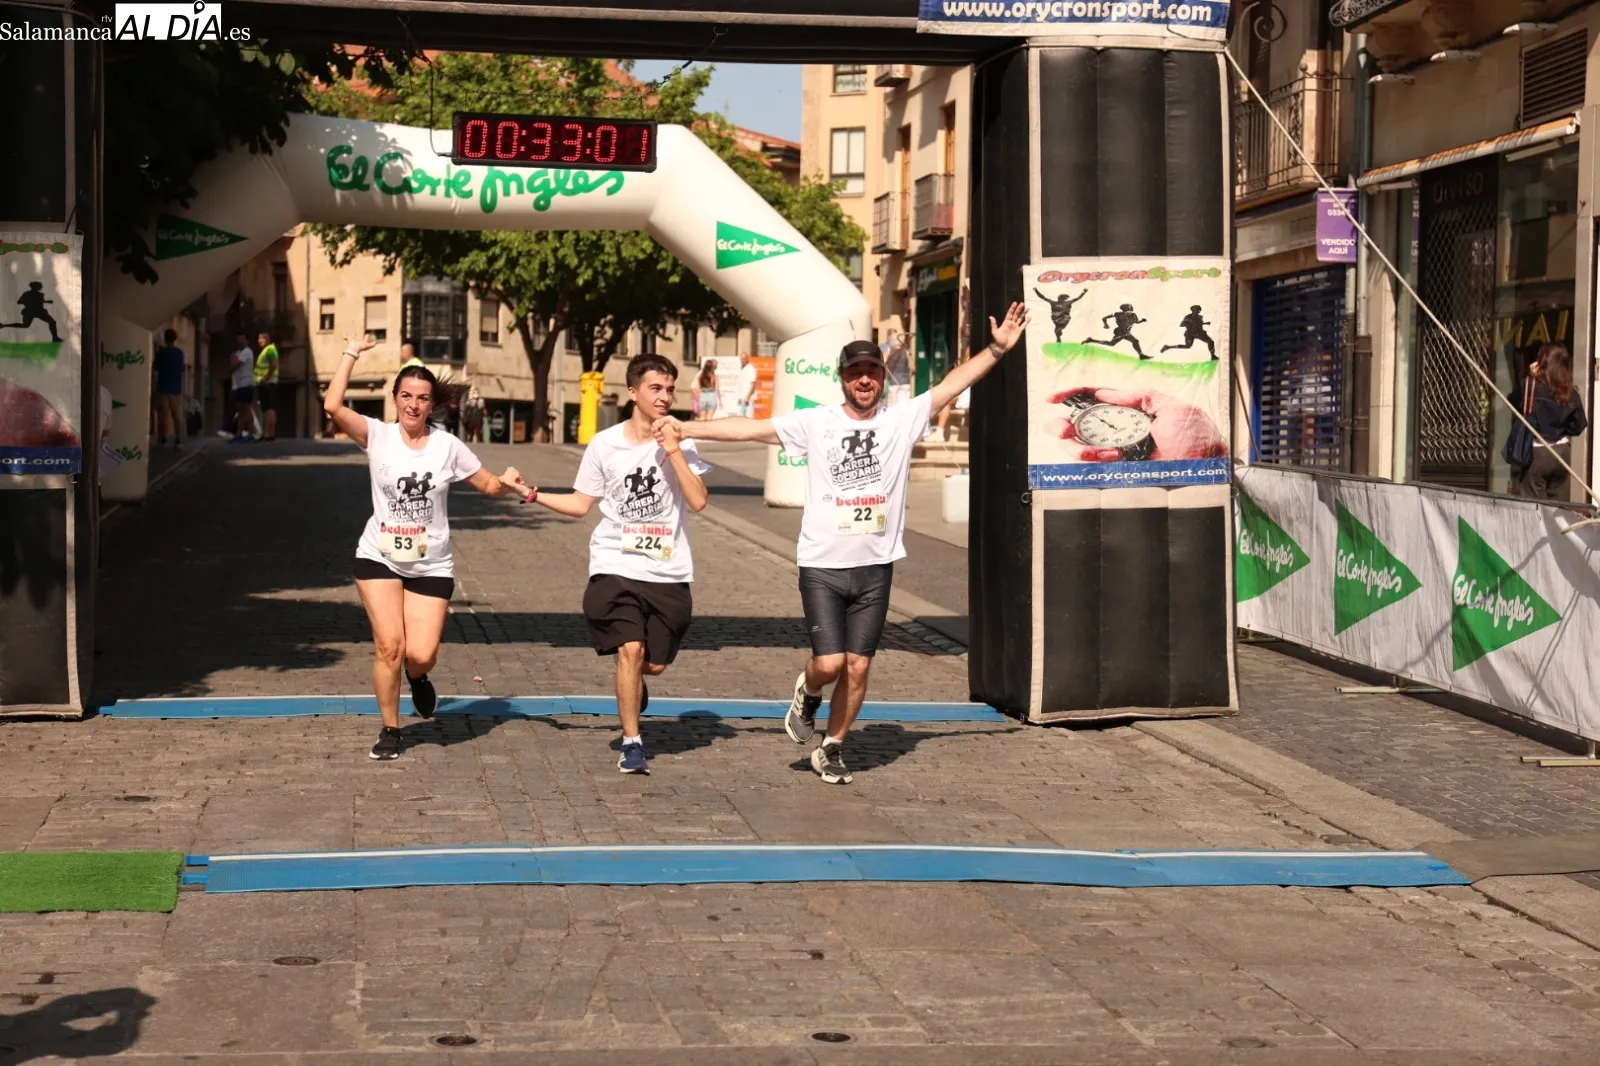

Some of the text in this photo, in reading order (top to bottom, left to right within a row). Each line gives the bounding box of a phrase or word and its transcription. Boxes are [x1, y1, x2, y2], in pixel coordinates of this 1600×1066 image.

[943, 0, 1212, 22] www.orycronsport.com
[465, 120, 648, 163] 00:33:01
[326, 145, 370, 192] El
[373, 151, 473, 198] Corte
[1321, 238, 1356, 246] VENDIDO
[785, 357, 795, 374] El
[796, 359, 831, 377] Corte
[831, 455, 879, 475] CARRERA
[1043, 467, 1226, 482] www.orycronsport.com
[854, 507, 872, 521] 22
[623, 523, 673, 536] bedunia
[394, 537, 413, 550] 53
[635, 536, 662, 550] 224
[1266, 529, 1294, 573] Inglés
[1337, 549, 1402, 599] El Corte Inglés
[1454, 574, 1534, 631] El Corte Inglés
